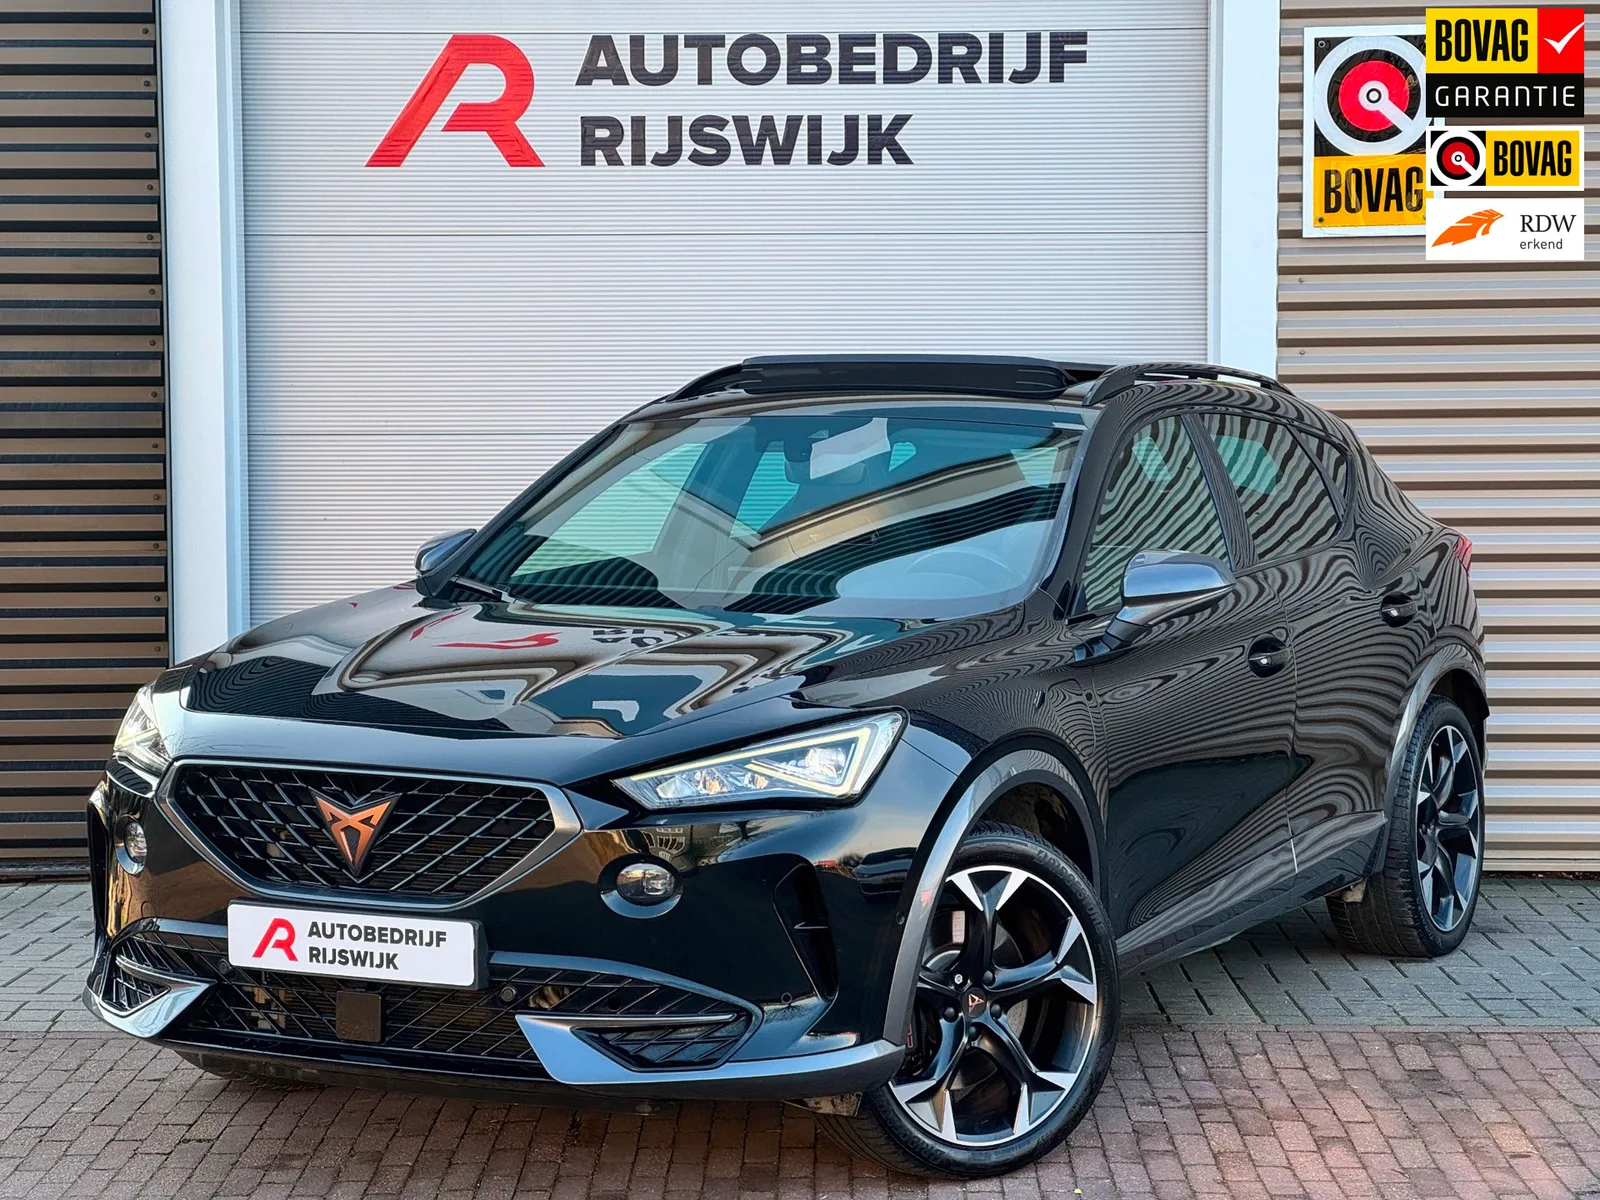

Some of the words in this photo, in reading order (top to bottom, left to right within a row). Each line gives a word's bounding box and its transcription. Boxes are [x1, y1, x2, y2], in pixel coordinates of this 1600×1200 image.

[575, 32, 1088, 86] AUTOBEDRIJF
[580, 114, 914, 167] RIJSWIJK
[1323, 166, 1424, 214] BOVAG
[308, 921, 447, 948] AUTOBEDRIJF
[308, 946, 399, 970] RIJSWIJK
